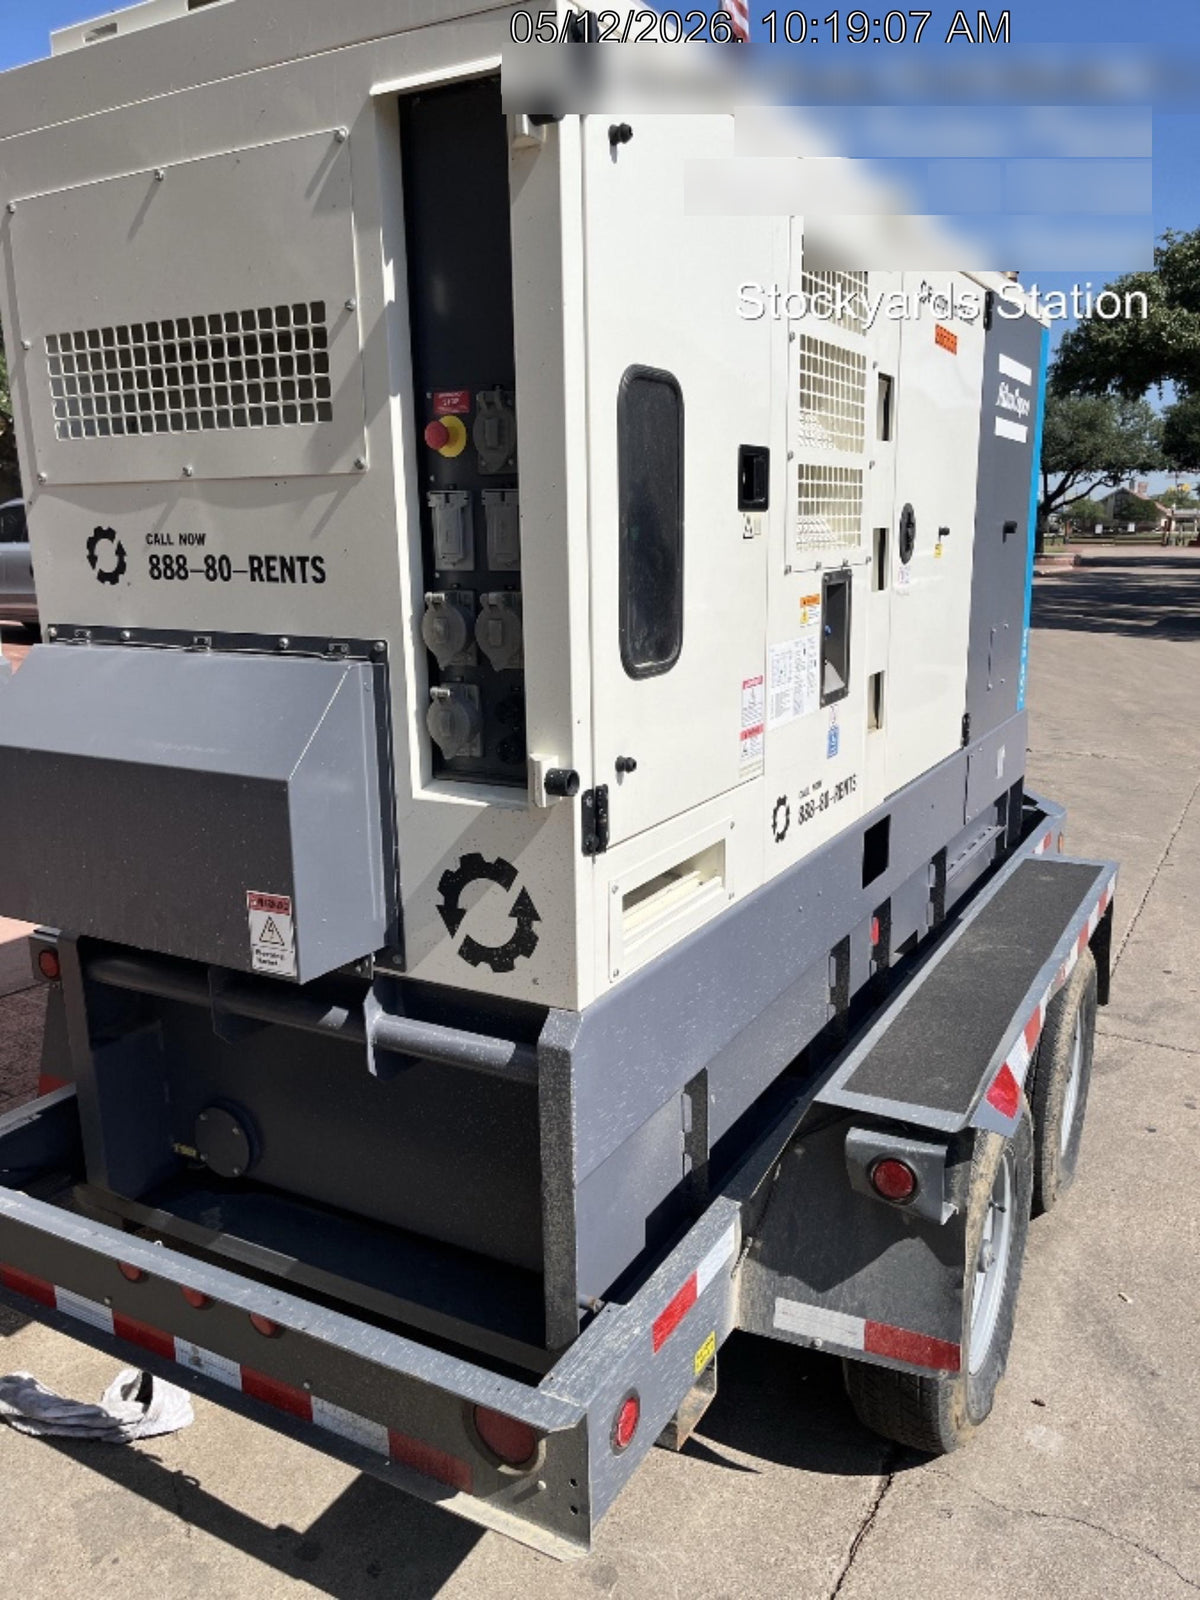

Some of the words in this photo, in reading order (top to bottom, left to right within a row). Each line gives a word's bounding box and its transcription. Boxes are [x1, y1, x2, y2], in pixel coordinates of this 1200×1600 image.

[145, 533, 174, 545] CALL
[178, 533, 206, 546] NOW
[148, 554, 327, 584] 888-80-RENTS
